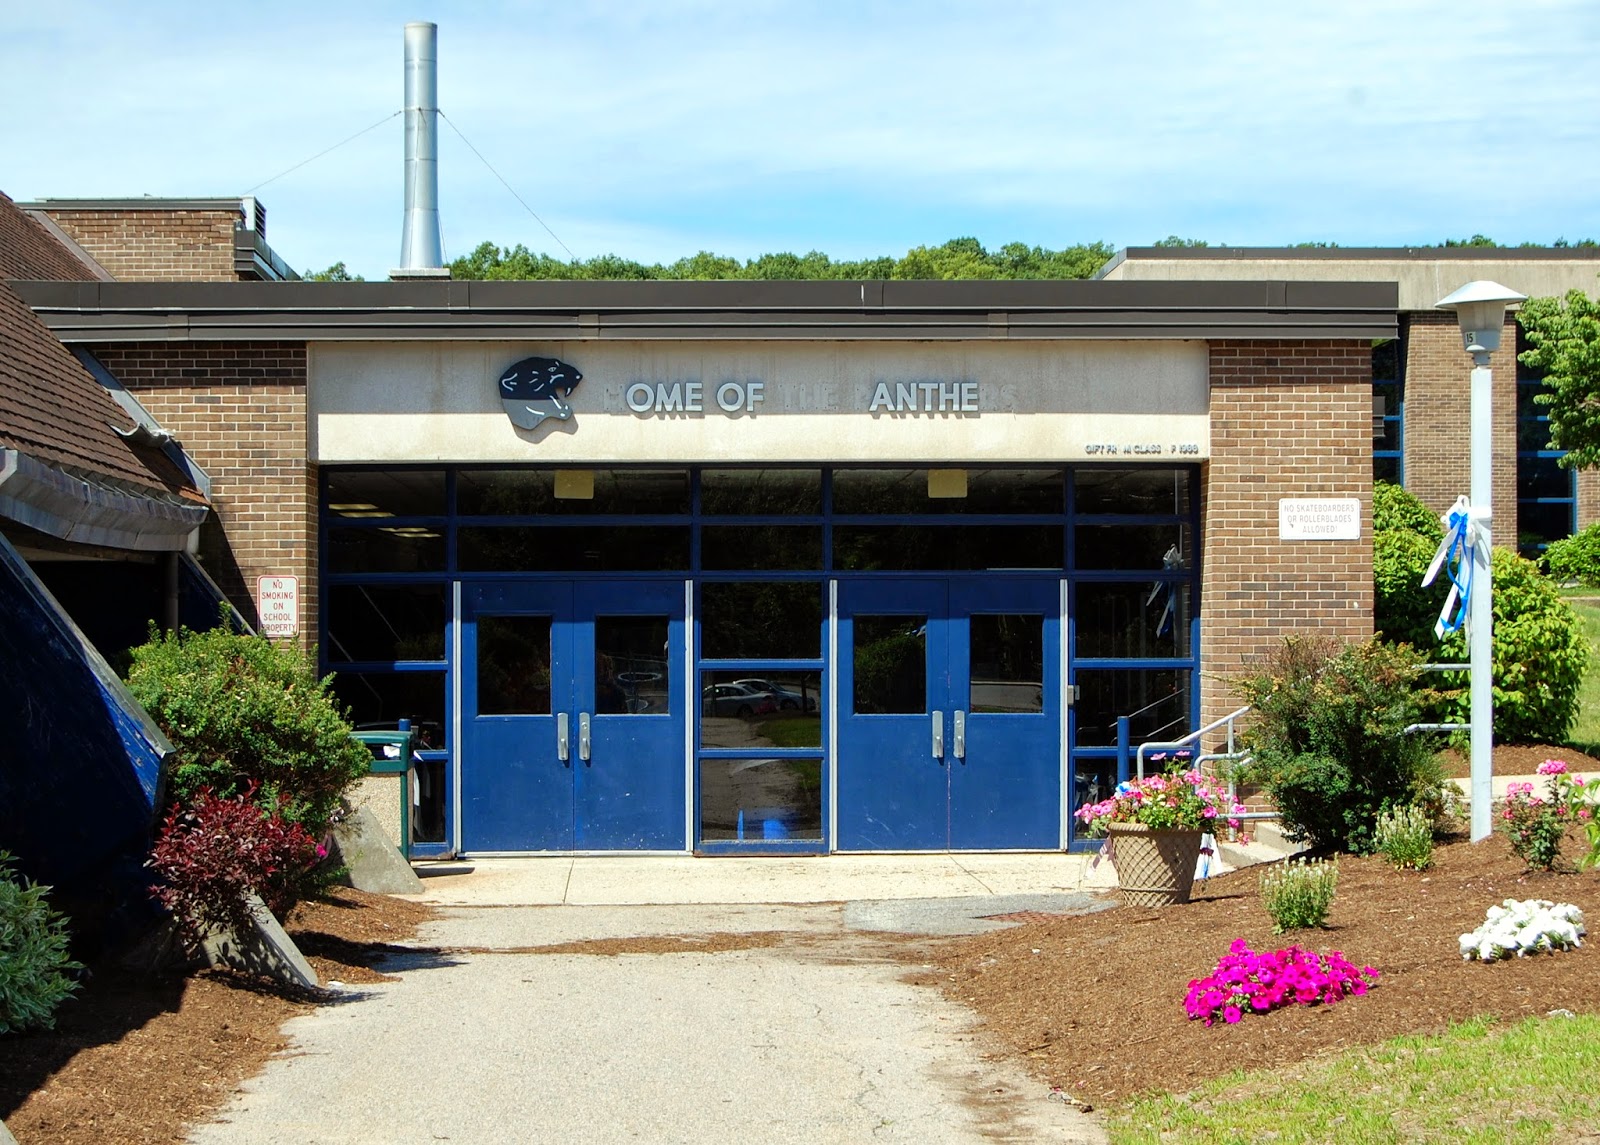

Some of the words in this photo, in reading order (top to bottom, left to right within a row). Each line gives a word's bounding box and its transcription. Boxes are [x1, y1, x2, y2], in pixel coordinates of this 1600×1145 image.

[1466, 333, 1474, 343] 15
[716, 382, 764, 412] OF
[1085, 444, 1105, 454] GIFT
[1133, 444, 1162, 454] CLASS
[1284, 504, 1294, 512] NO
[1296, 504, 1355, 512] SKATEBOARDERS
[1287, 515, 1297, 523] OR
[1299, 514, 1352, 523] ROLLERBLADES
[272, 581, 283, 589] NO
[261, 592, 294, 600] SMOKING
[273, 602, 284, 610] ON
[263, 613, 292, 621] SCHOOL
[262, 623, 296, 631] PROPERTY
